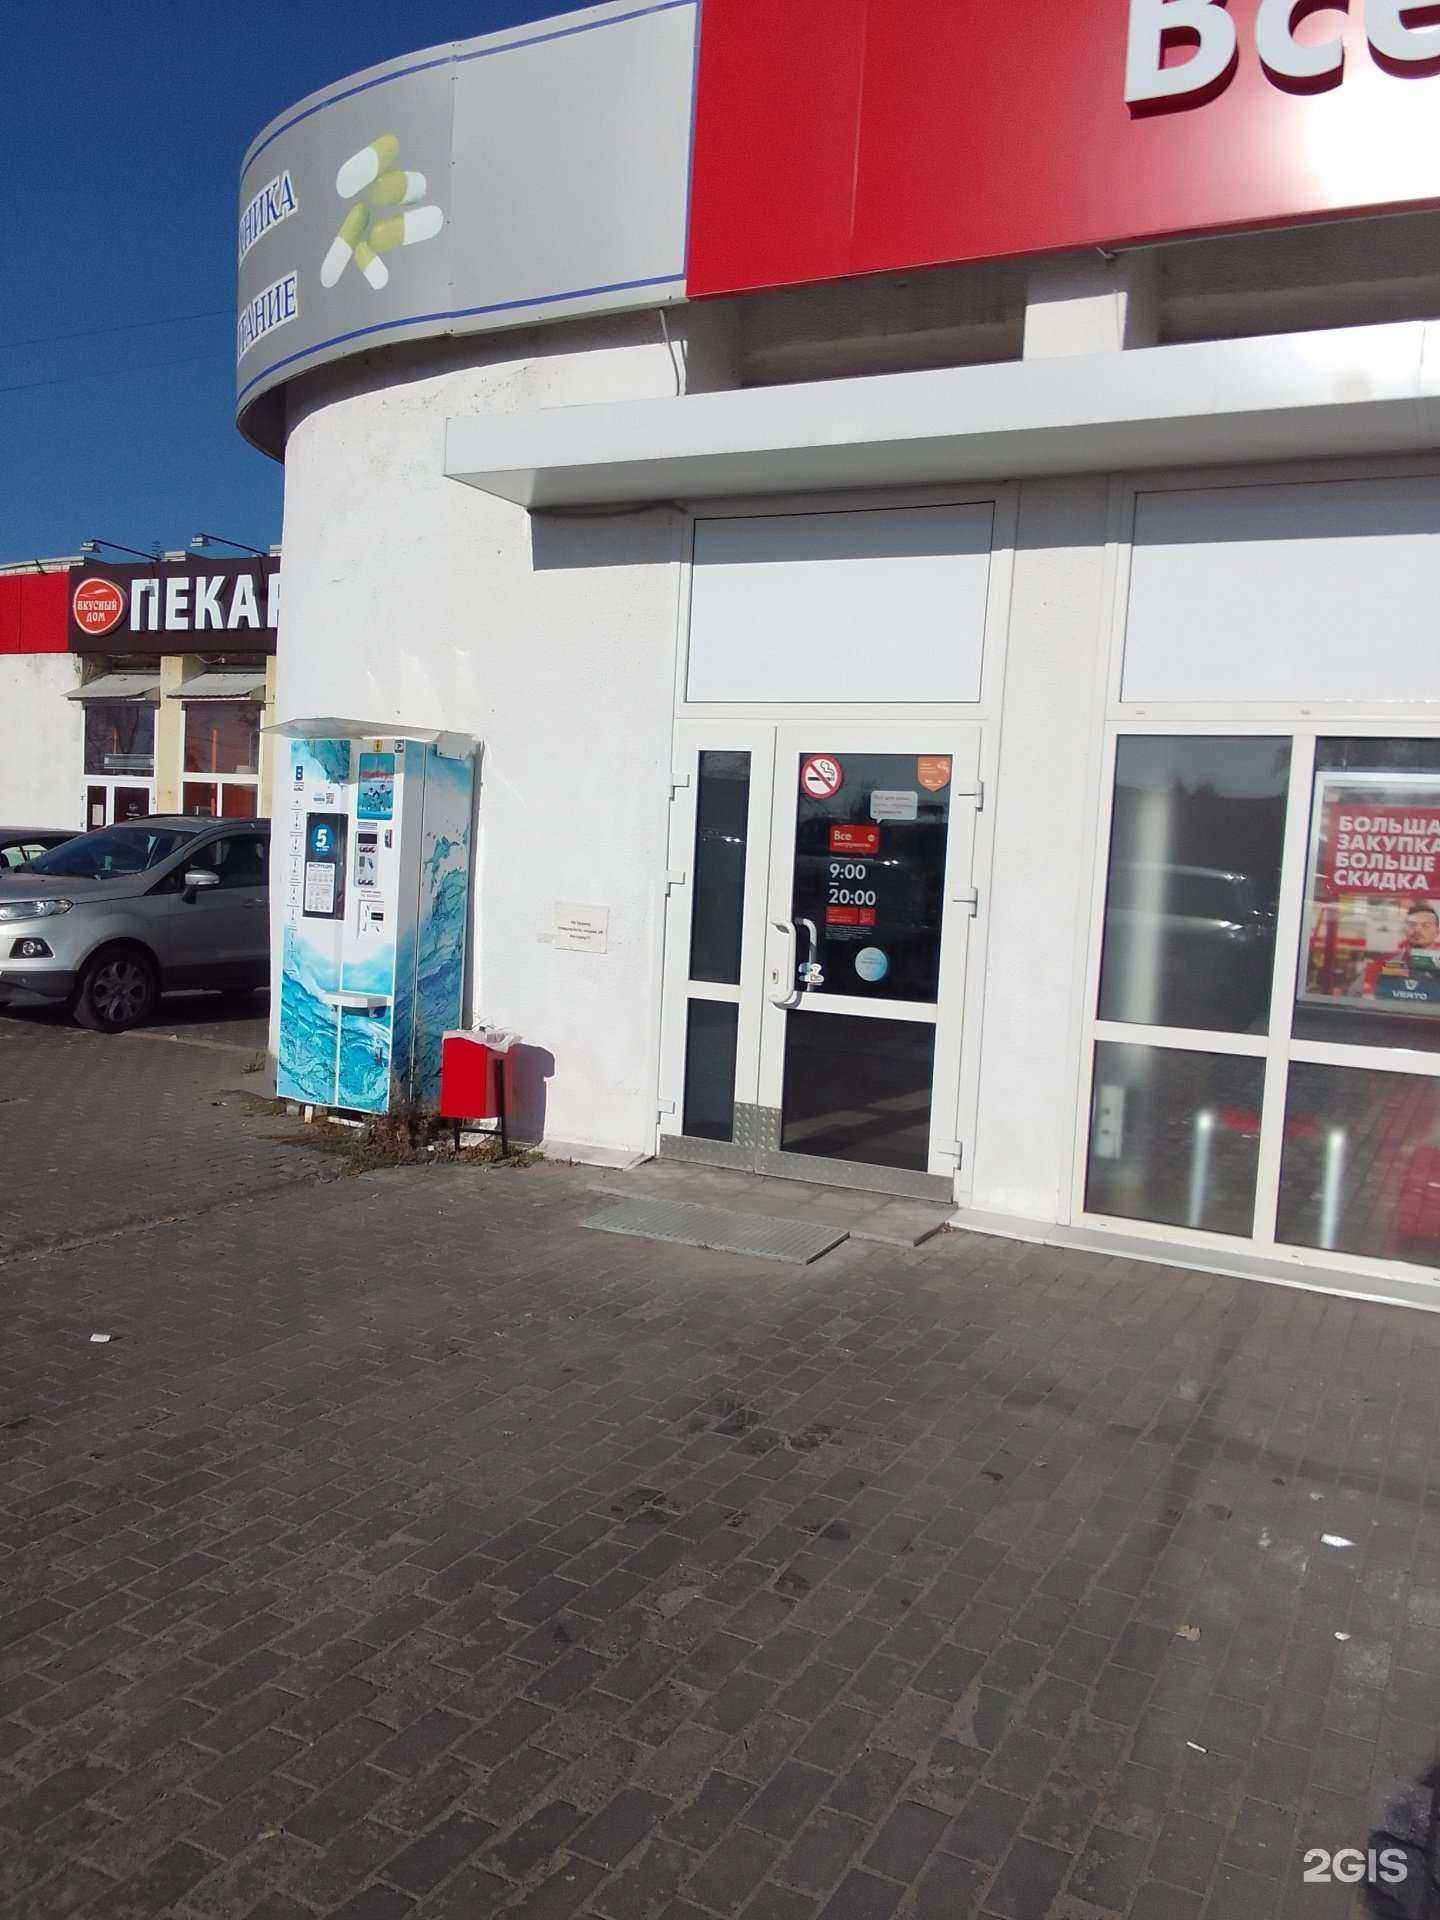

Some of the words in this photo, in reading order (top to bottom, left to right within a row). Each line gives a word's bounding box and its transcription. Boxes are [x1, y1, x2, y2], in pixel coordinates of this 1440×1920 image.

[77, 599, 118, 611] ВКУСНЫЙ
[86, 612, 105, 623] ДОМ
[1335, 852, 1435, 873] БОЛЬШЕ
[829, 863, 866, 880] 9:00
[1334, 869, 1429, 891] СКИДКА
[828, 888, 876, 906] 20:00
